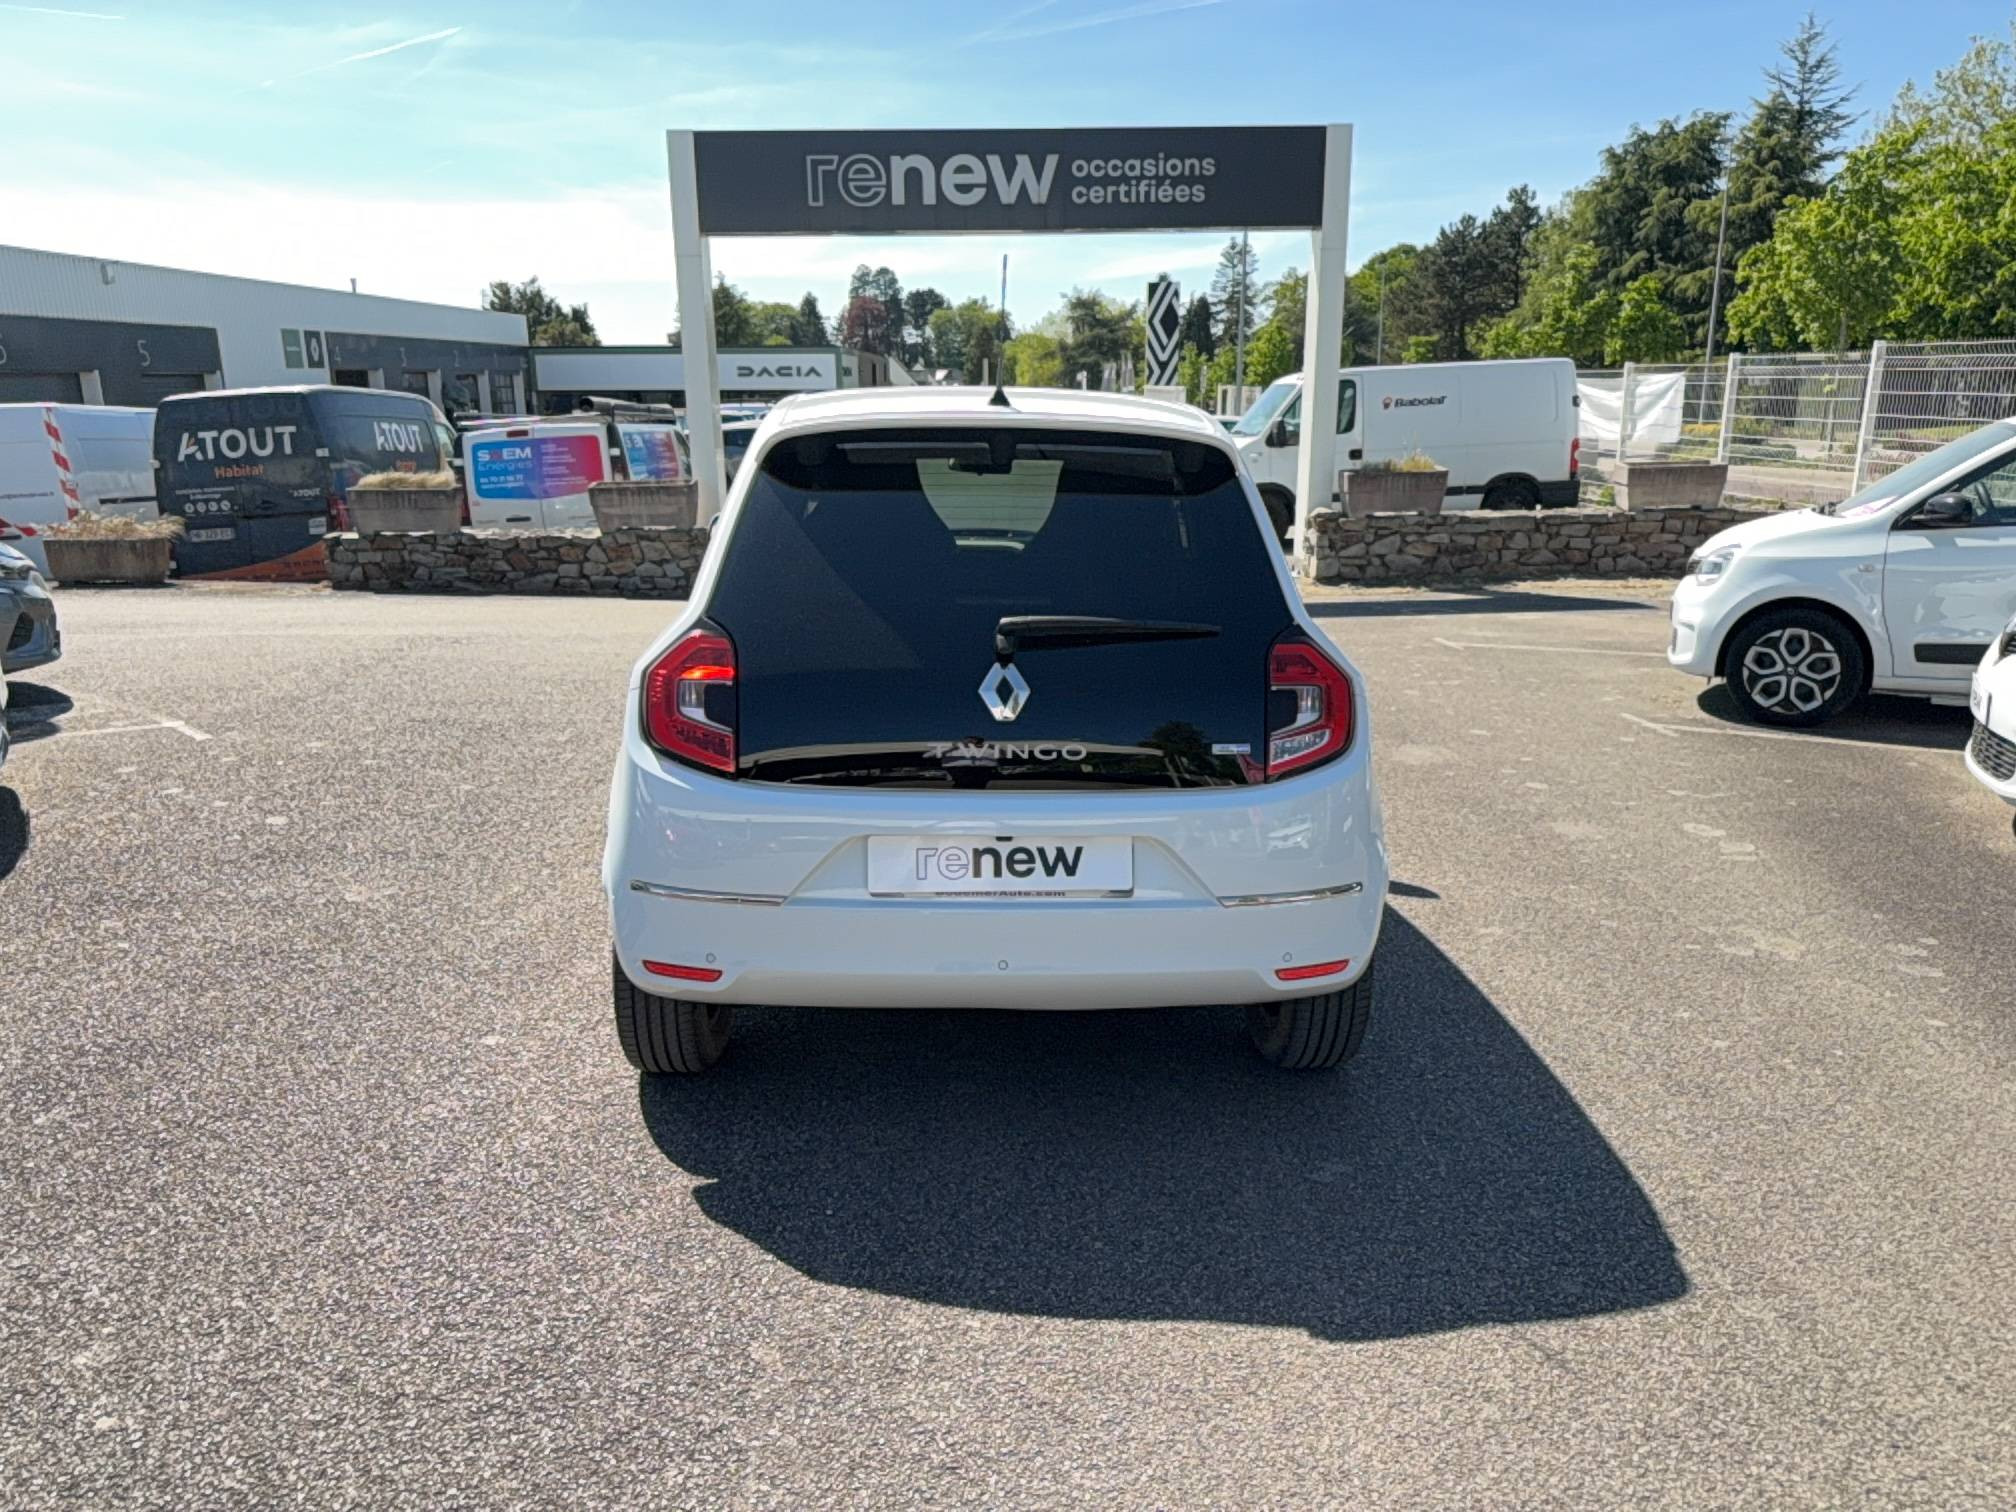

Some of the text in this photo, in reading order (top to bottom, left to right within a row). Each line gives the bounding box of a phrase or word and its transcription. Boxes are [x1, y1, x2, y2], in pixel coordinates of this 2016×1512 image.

[806, 153, 1216, 207] renew occasions
[1071, 182, 1206, 204] certifiées
[136, 339, 151, 367] 5
[736, 366, 822, 377] DACIA
[177, 425, 297, 462] ATOUT
[373, 421, 423, 453] ATOUT
[214, 463, 264, 479] Habitat
[927, 743, 1088, 761] TWINGO
[915, 846, 1084, 880] renew
